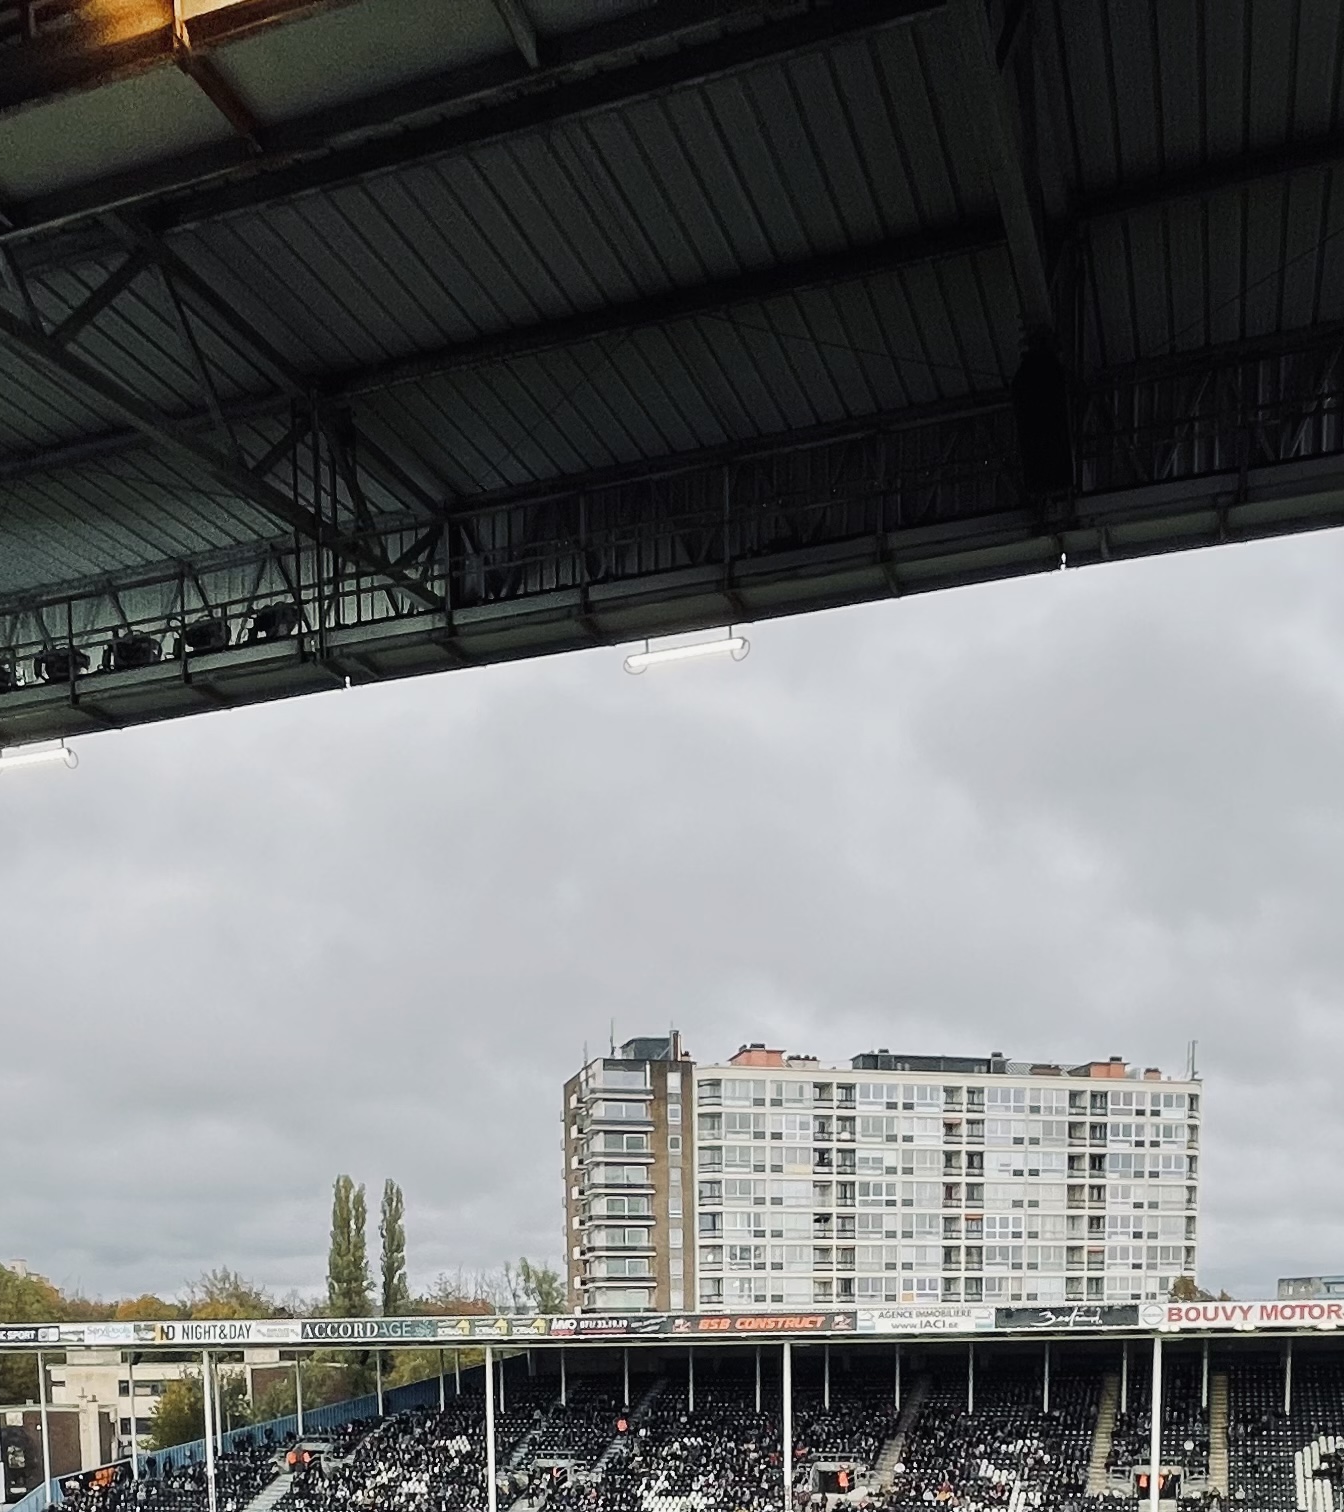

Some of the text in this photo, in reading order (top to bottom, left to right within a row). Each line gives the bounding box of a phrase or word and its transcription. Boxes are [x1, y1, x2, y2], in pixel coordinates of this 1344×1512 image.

[878, 1310, 914, 1319] AGENCE
[1167, 1304, 1344, 1323] BOUVY MOTOR
[734, 1316, 825, 1330] CONSTRUCT
[182, 1324, 252, 1340] NIGHT&DAY
